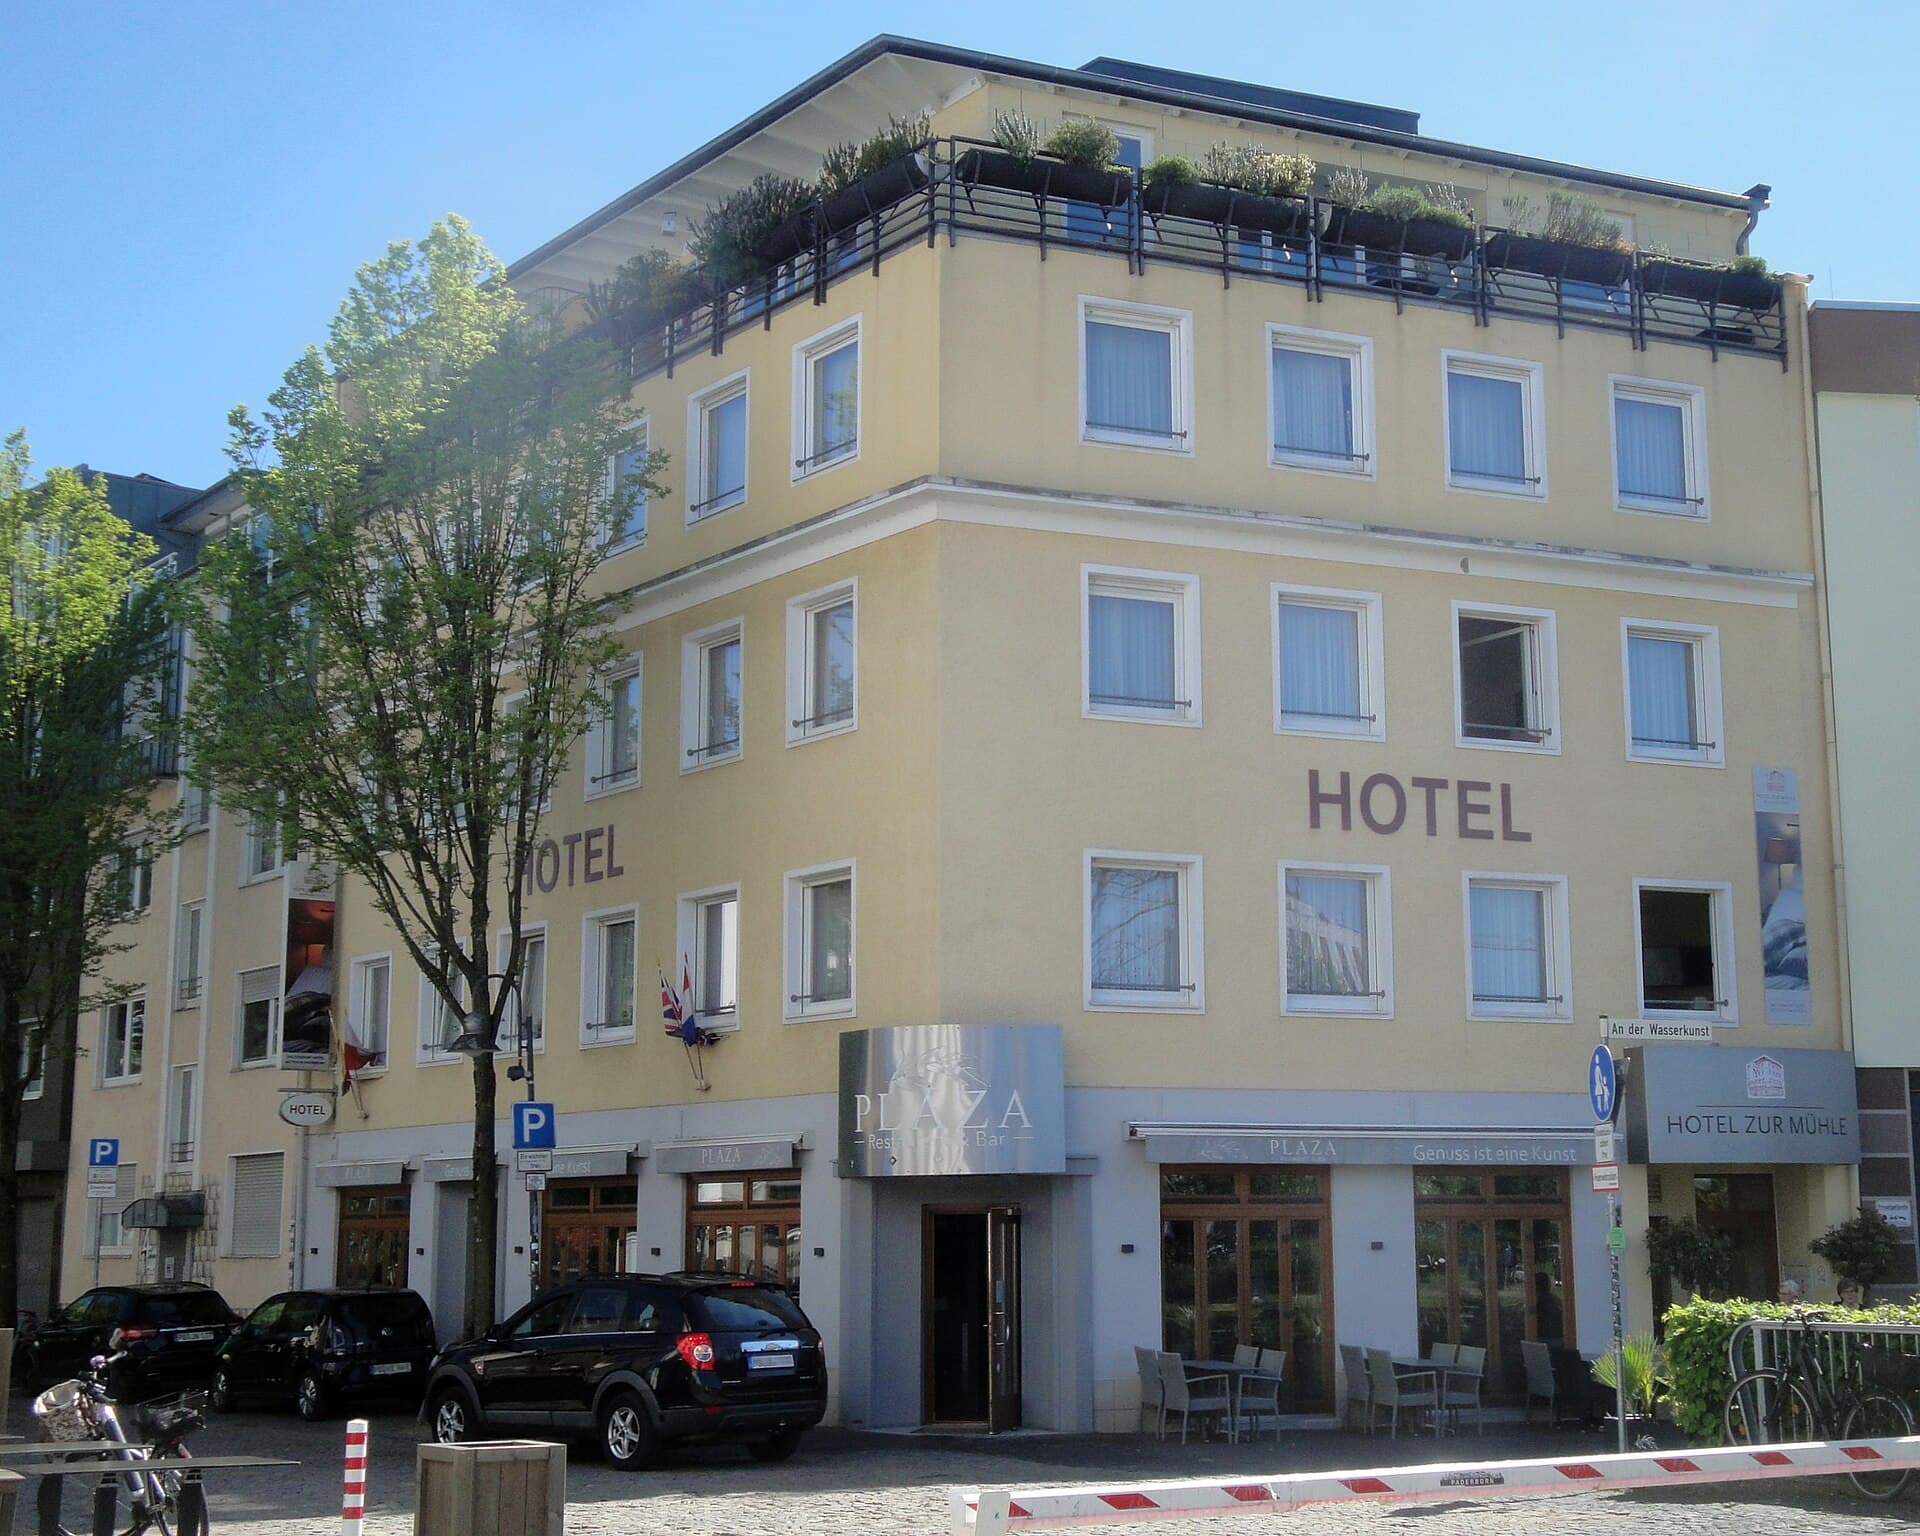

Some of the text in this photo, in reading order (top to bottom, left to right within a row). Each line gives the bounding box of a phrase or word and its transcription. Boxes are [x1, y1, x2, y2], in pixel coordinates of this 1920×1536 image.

[1308, 769, 1532, 842] HOTEL
[1611, 1023, 1709, 1036] An der Wasserkunst
[289, 1104, 326, 1115] HOTEL
[854, 1089, 1033, 1133] PLAZA
[523, 1108, 546, 1142] P
[1667, 1113, 1848, 1136] HOTEL ZUR MÜHLE
[976, 1131, 1006, 1147] Bar
[1270, 1139, 1337, 1156] PLAZA
[96, 1142, 112, 1163] P
[702, 1147, 741, 1163] PLAZA
[1413, 1145, 1577, 1161] Genuss ist eine Kunst
